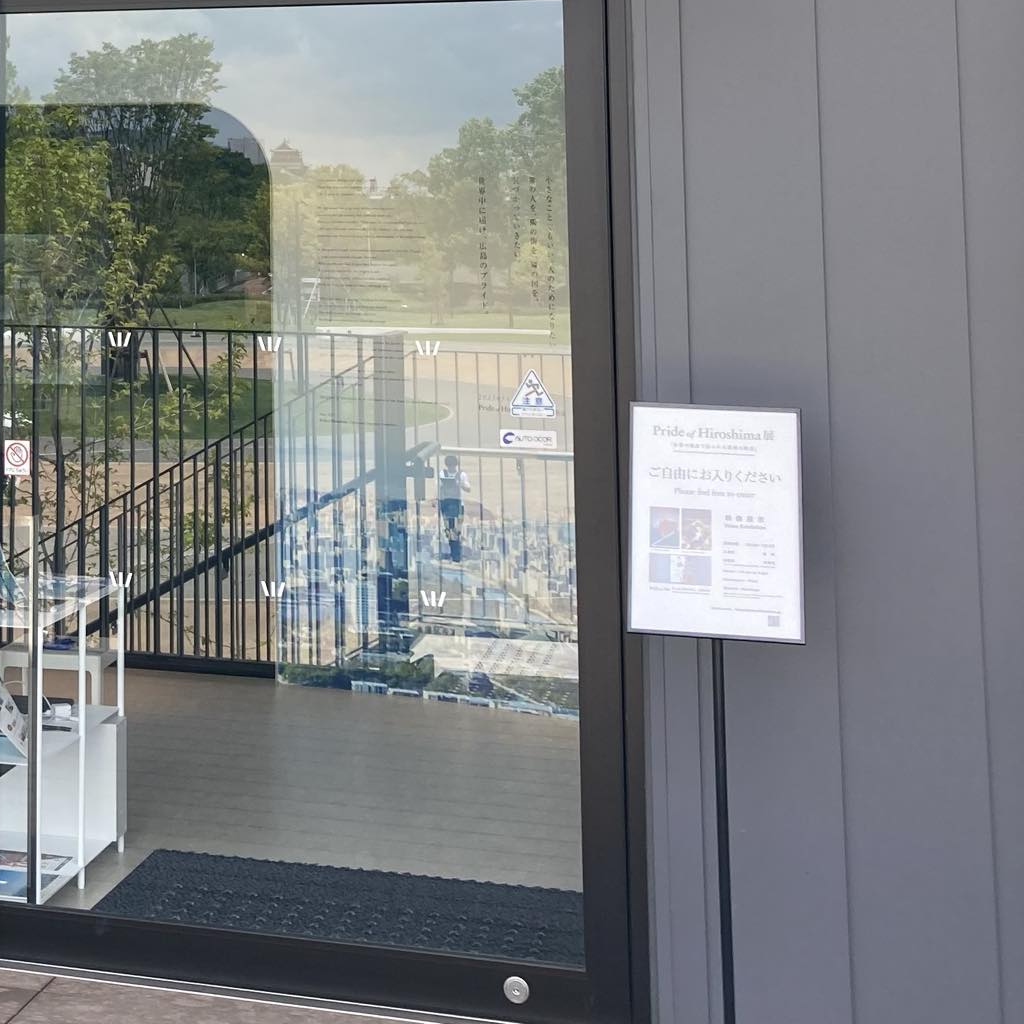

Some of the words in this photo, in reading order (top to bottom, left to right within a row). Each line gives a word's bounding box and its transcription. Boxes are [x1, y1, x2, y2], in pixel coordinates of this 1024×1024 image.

[652, 425, 685, 437] Pride
[686, 429, 697, 439] of
[698, 427, 762, 441] Hiroshima
[648, 466, 782, 483] ご自由にお入りください
